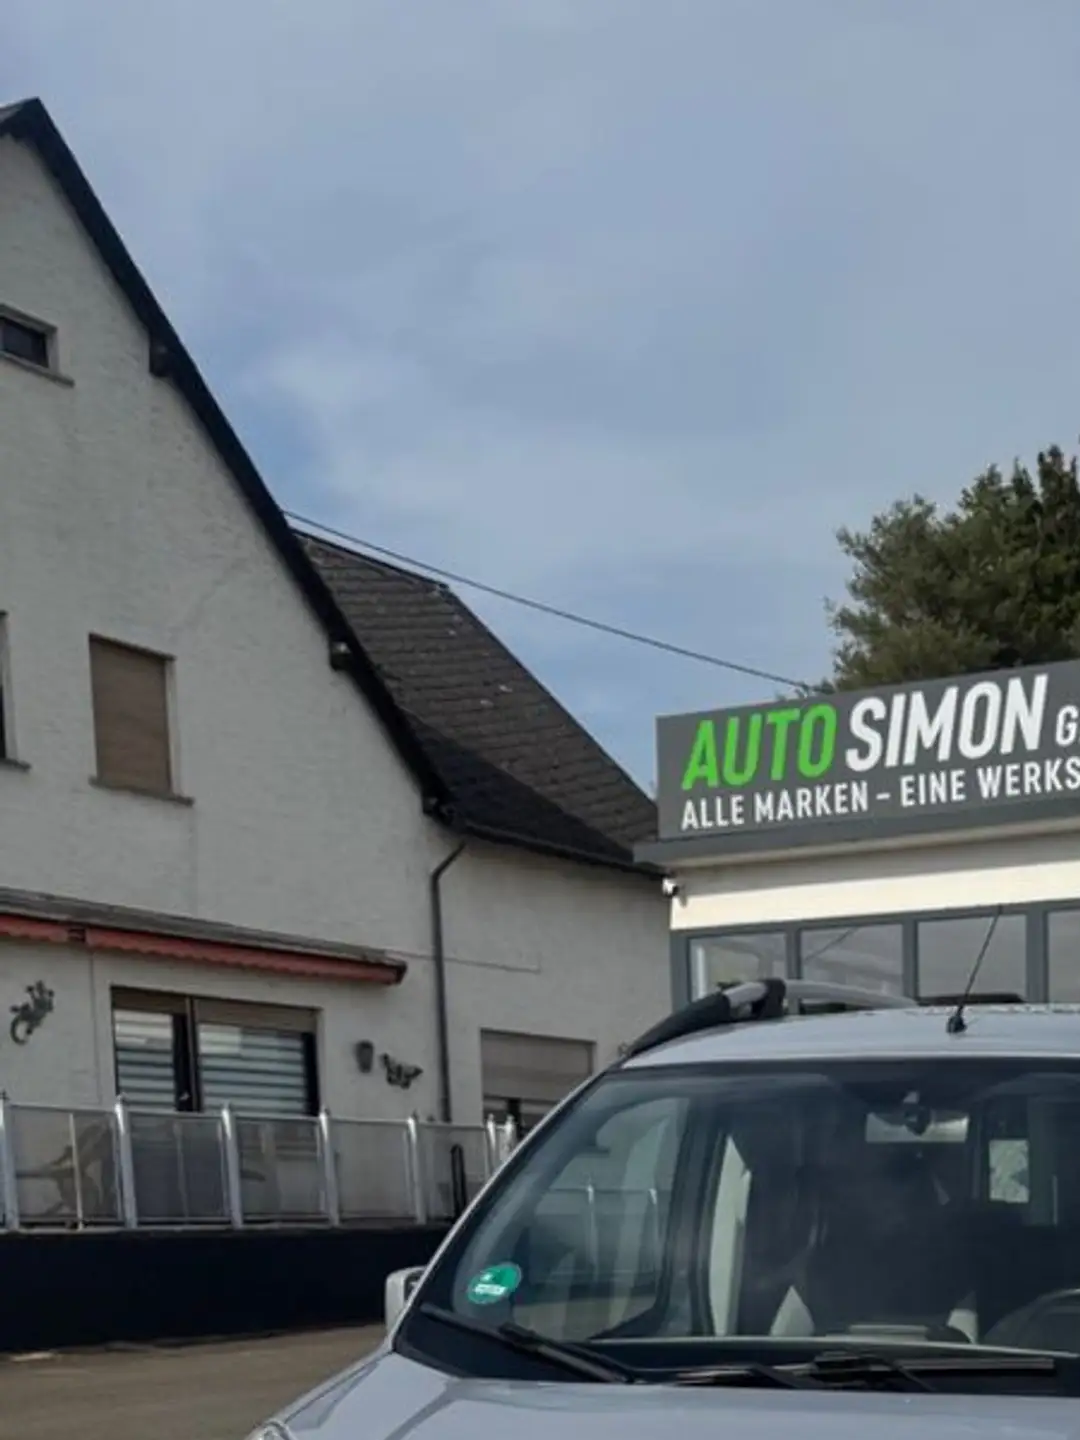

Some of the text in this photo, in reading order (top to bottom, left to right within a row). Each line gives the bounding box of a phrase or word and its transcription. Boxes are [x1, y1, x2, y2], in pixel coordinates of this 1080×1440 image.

[681, 703, 838, 791] AUTO
[845, 673, 1048, 773] SIMON
[681, 795, 745, 832] ALLE
[754, 780, 869, 824] MARKEN
[900, 769, 966, 807] EINE
